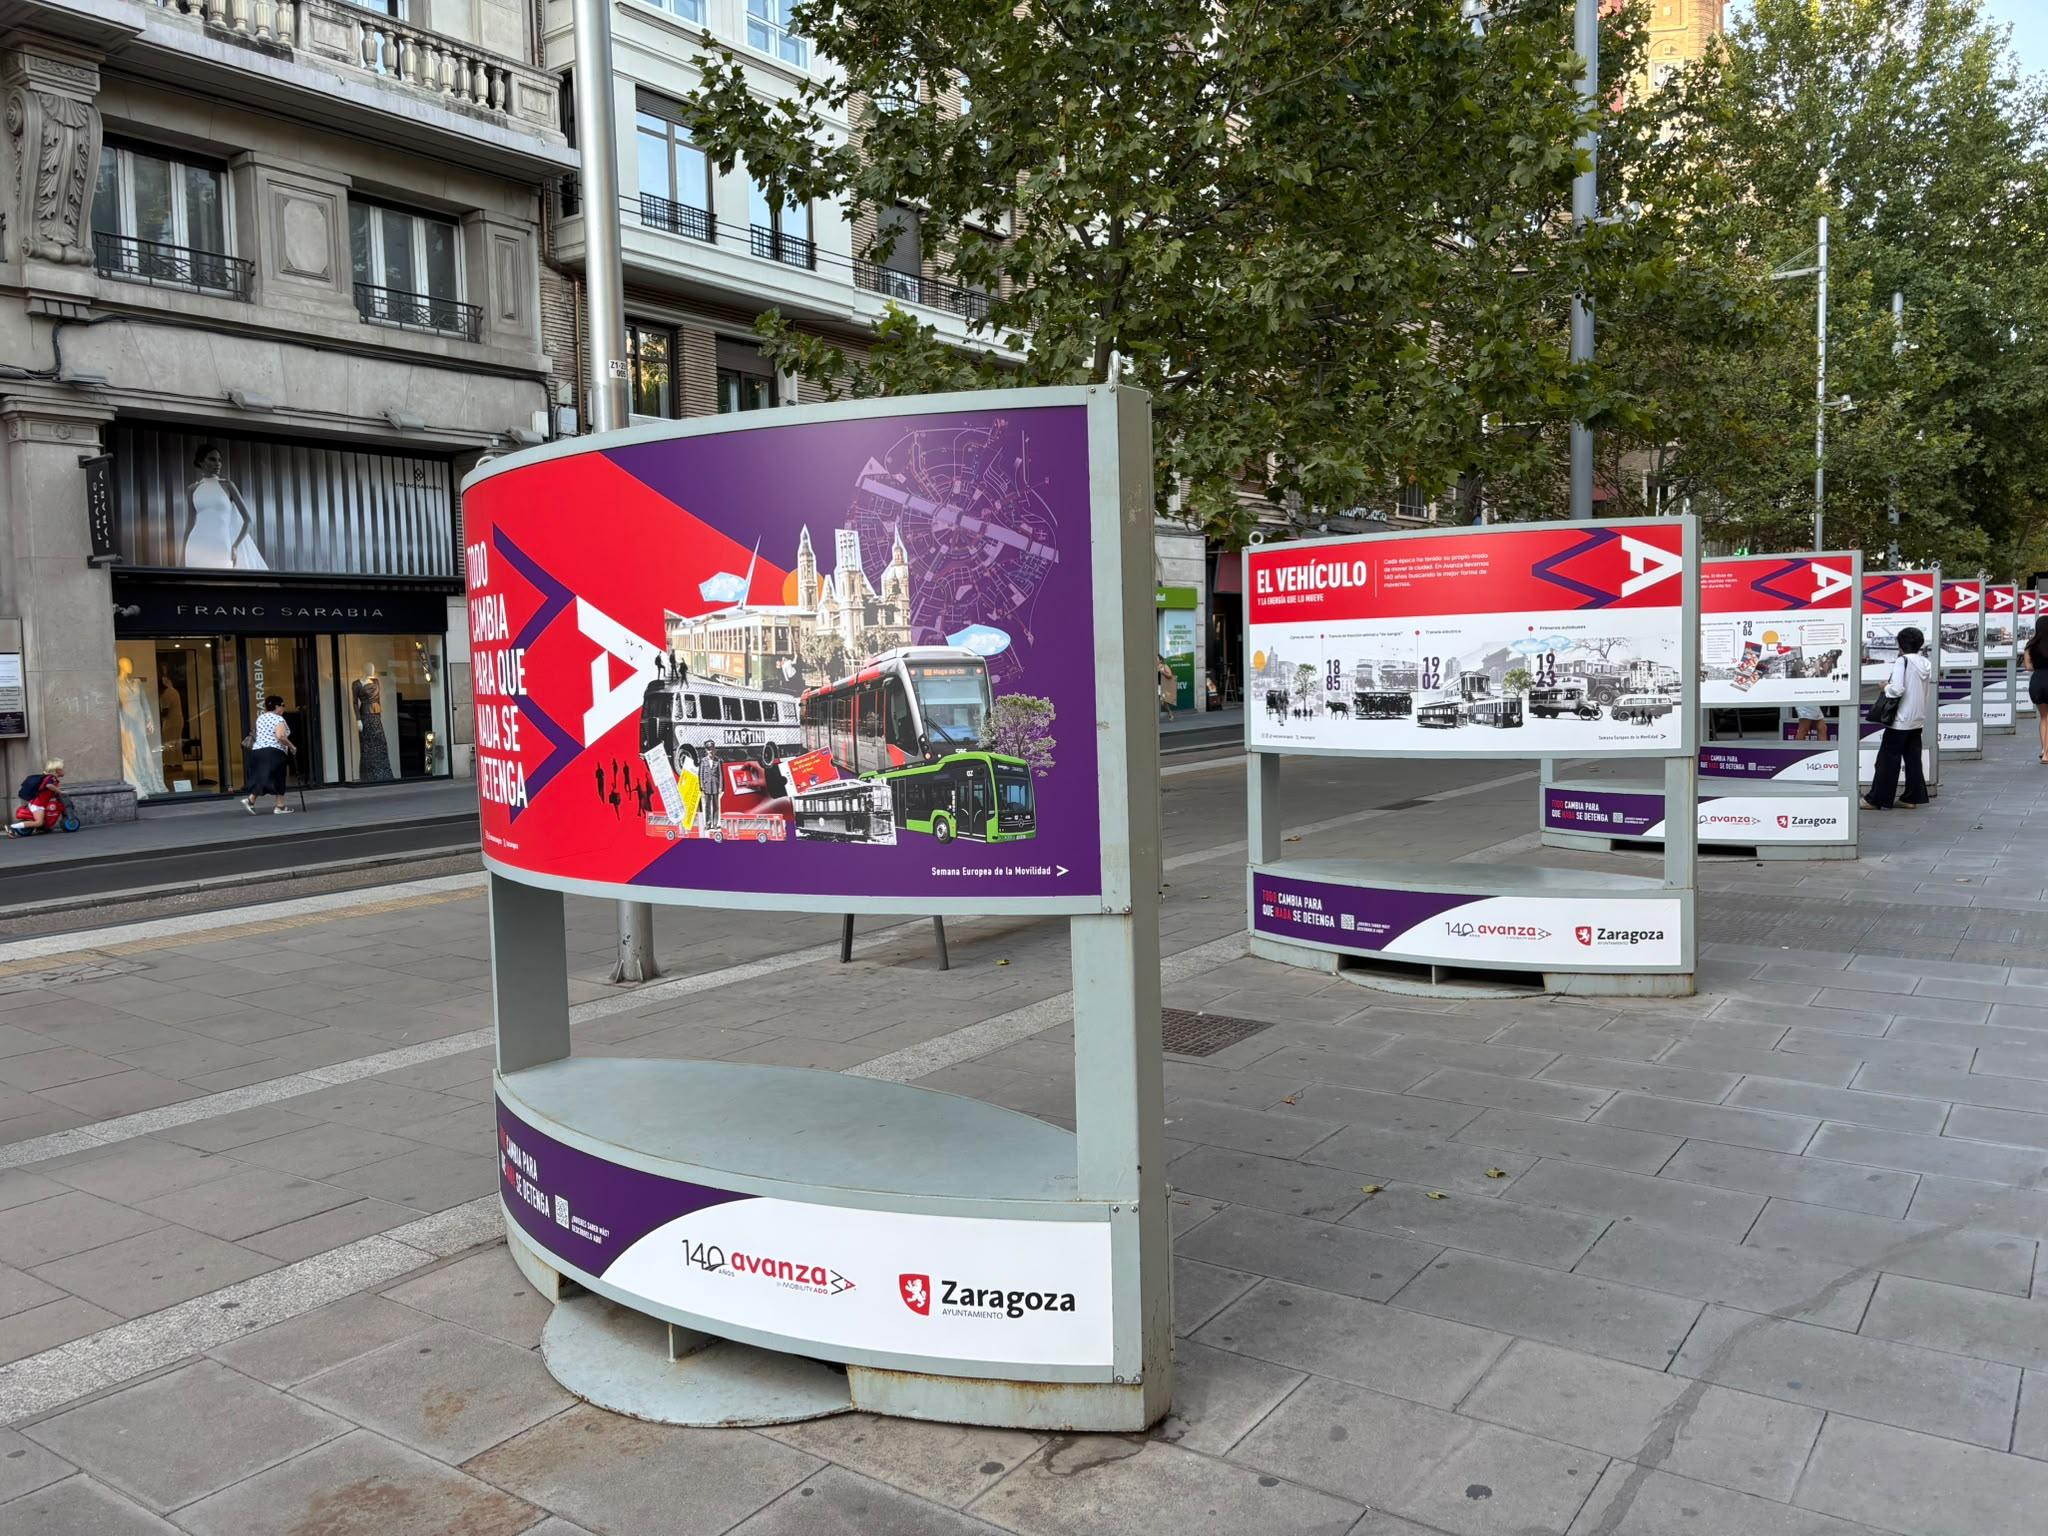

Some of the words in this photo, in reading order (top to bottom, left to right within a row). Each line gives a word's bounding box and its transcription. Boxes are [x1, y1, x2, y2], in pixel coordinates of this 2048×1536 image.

[92, 481, 102, 541] FRANC
[98, 469, 110, 549] SARABIA
[467, 540, 489, 591] TODO
[1257, 569, 1273, 594] EL
[1276, 558, 1367, 592] VEHÍCULO
[1287, 595, 1296, 603] QUE
[1297, 594, 1305, 603] LO
[1305, 593, 1324, 603] MUEVE
[176, 605, 265, 617] FRANC
[280, 606, 384, 618] SARABIA
[471, 592, 509, 643] CAMBIA
[1327, 659, 1341, 675] 18
[1423, 656, 1440, 673] 19
[1536, 653, 1555, 671] 19
[474, 650, 496, 695] PARA
[497, 647, 527, 696] QUE
[1536, 670, 1556, 688] 23
[1326, 675, 1341, 691] 85
[1422, 673, 1441, 690] 02
[477, 703, 501, 751] NADA
[501, 704, 521, 752] SE
[724, 729, 766, 745] MARTINI
[480, 755, 528, 809] DETENGA
[1564, 800, 1585, 810] CAMBIA
[1585, 802, 1600, 812] PARA
[1551, 809, 1561, 818] QUE
[1576, 812, 1583, 820] SE
[1584, 813, 1609, 823] DETENGA
[1710, 815, 1751, 823] avanza
[1792, 816, 1837, 828] Zaragoza
[931, 867, 961, 876] Semana
[962, 866, 993, 878] Europea
[994, 866, 1004, 876] de
[1005, 866, 1013, 876] la
[1014, 866, 1052, 876] Movilidad
[1278, 892, 1303, 908] CAMBIA
[1304, 897, 1323, 911] PARA
[1262, 904, 1275, 917] QUE
[1293, 909, 1302, 922] SE
[1303, 911, 1335, 928] DETENGA
[1477, 924, 1537, 937] avanza
[1597, 928, 1664, 945] Zaragoza
[522, 1151, 538, 1182] PARA
[515, 1171, 523, 1197] SE
[522, 1178, 551, 1218] DETENGA
[682, 1239, 727, 1272] 140
[731, 1250, 828, 1287] avanza
[718, 1268, 736, 1278] AÑOS
[782, 1281, 813, 1293] MOBILITY
[813, 1287, 829, 1296] ADO
[941, 1280, 1076, 1319] Zaragoza
[942, 1309, 1004, 1320] AYUNTAMIENTO
